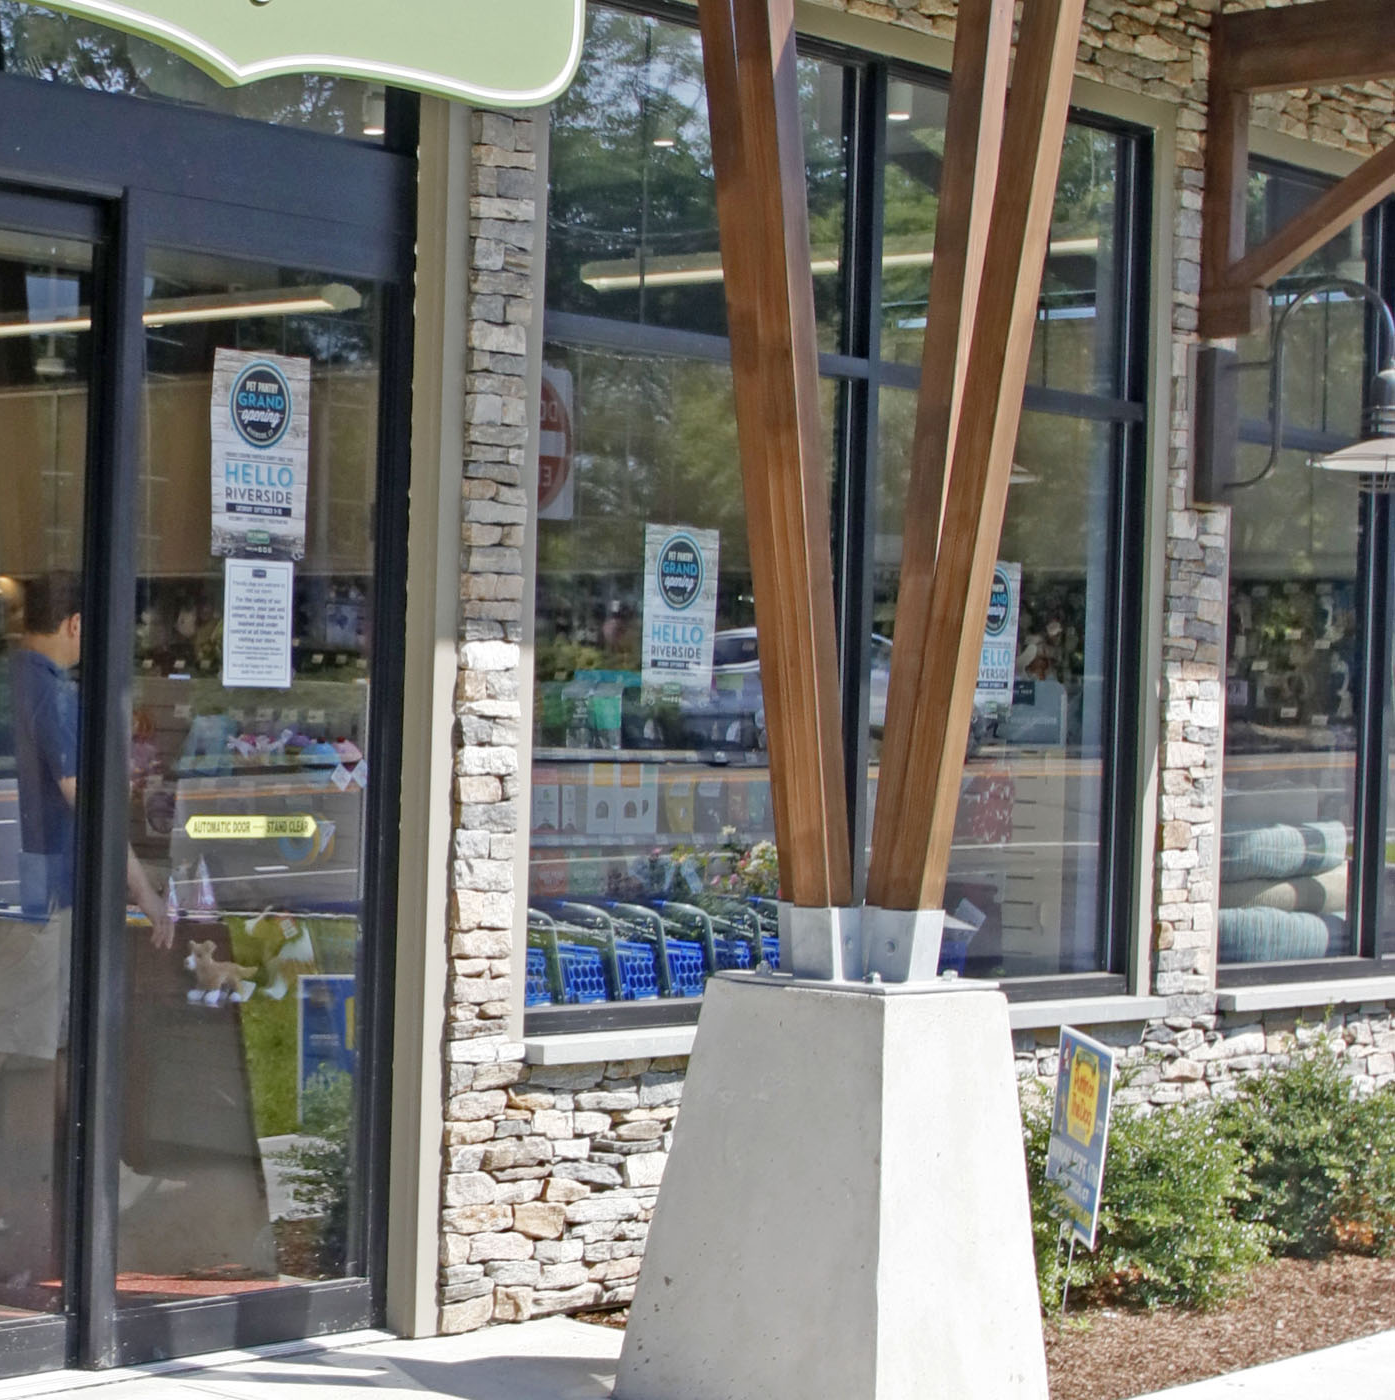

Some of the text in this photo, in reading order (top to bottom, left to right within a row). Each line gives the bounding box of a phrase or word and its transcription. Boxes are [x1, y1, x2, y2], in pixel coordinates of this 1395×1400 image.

[246, 381, 256, 392] PET
[238, 392, 284, 410] GRAND
[241, 409, 281, 428] opening
[225, 462, 293, 487] HELLO
[225, 486, 292, 505] RIVERSIDE
[662, 561, 698, 576] GRAND
[651, 624, 704, 646] HELLO
[651, 644, 701, 660] RIVERSIDE
[982, 647, 1011, 666] ELLO
[193, 821, 309, 834] AUTOMATIC DOOR STAND CLEAR
